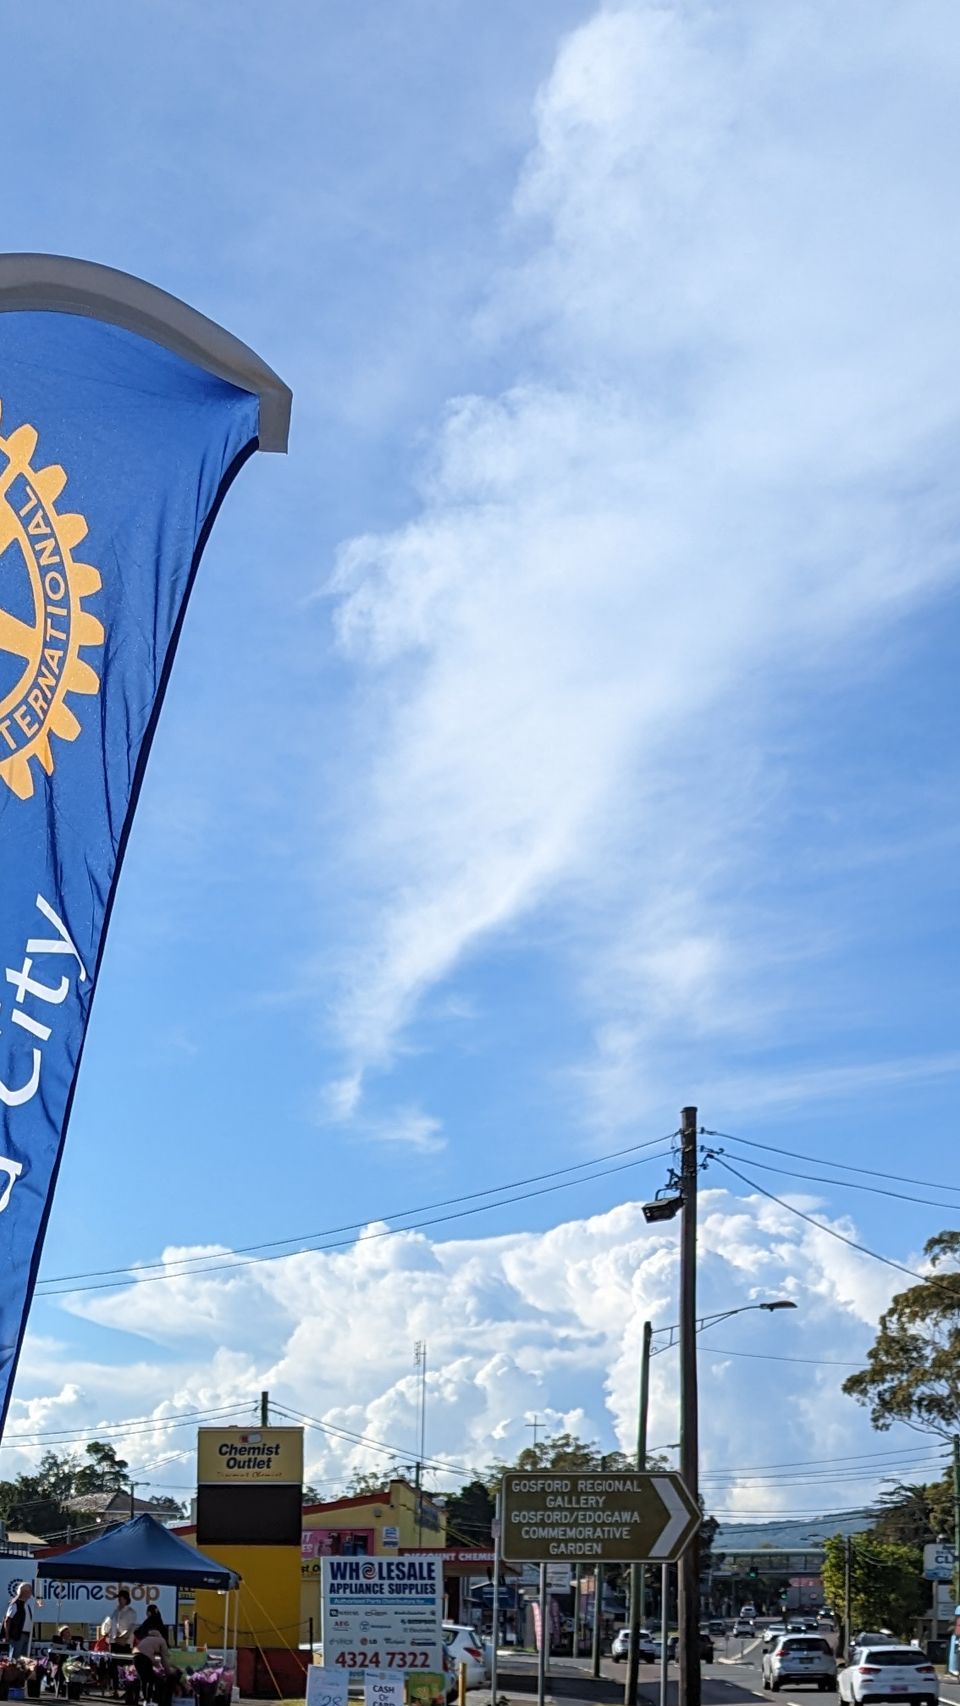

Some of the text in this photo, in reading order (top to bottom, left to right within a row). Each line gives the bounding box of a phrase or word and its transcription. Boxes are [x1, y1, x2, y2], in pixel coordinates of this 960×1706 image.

[218, 1443, 280, 1456] Chemist
[226, 1457, 272, 1469] Outlet
[512, 1480, 642, 1492] GOSFORD REGIONAL
[546, 1496, 606, 1508] GALLERY
[511, 1511, 640, 1523] GOSFORD/EDOGAWA
[521, 1527, 631, 1539] COMMEMORATIVE
[549, 1542, 602, 1555] GARDEN
[329, 1562, 436, 1580] WHOLESALE
[329, 1583, 436, 1595] APPLIANCE SUPPLIES
[335, 1651, 431, 1668] 4324 7322
[372, 1685, 395, 1694] CASH
